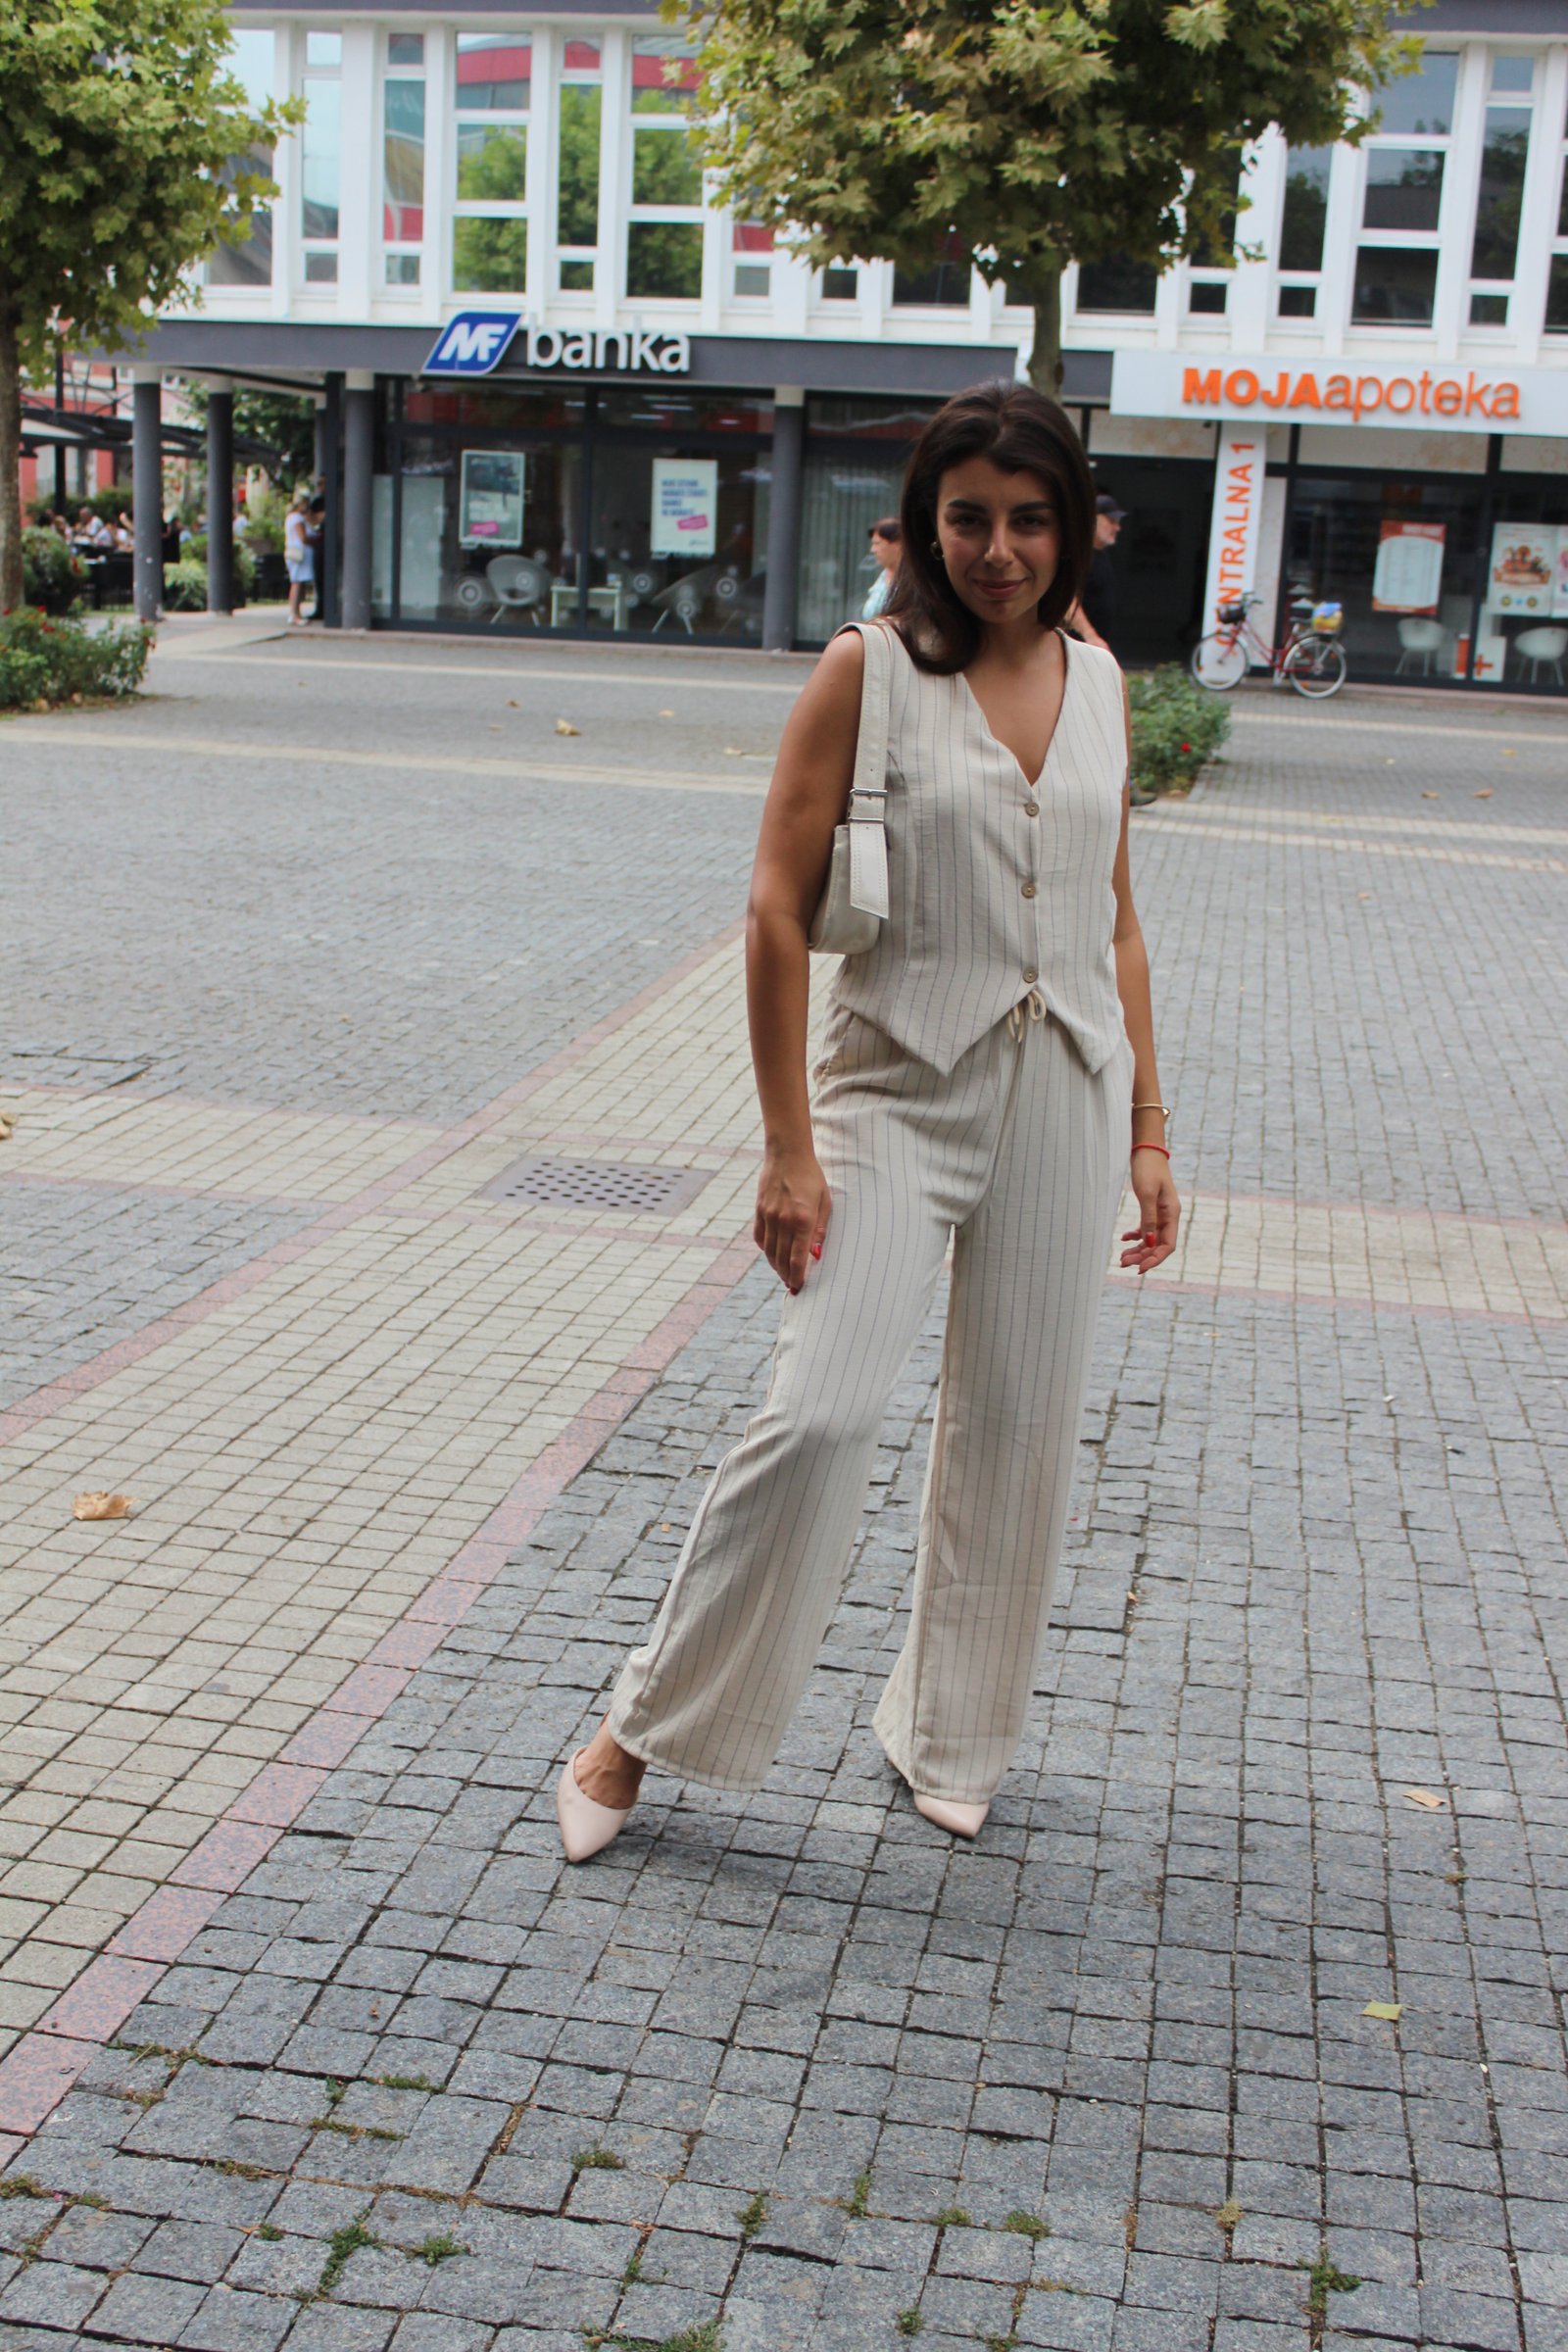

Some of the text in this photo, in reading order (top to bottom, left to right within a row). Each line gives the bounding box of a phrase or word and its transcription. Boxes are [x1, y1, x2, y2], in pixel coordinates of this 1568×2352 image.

[438, 312, 690, 372] MF banka
[1214, 443, 1255, 647] CNTRALNA 1
